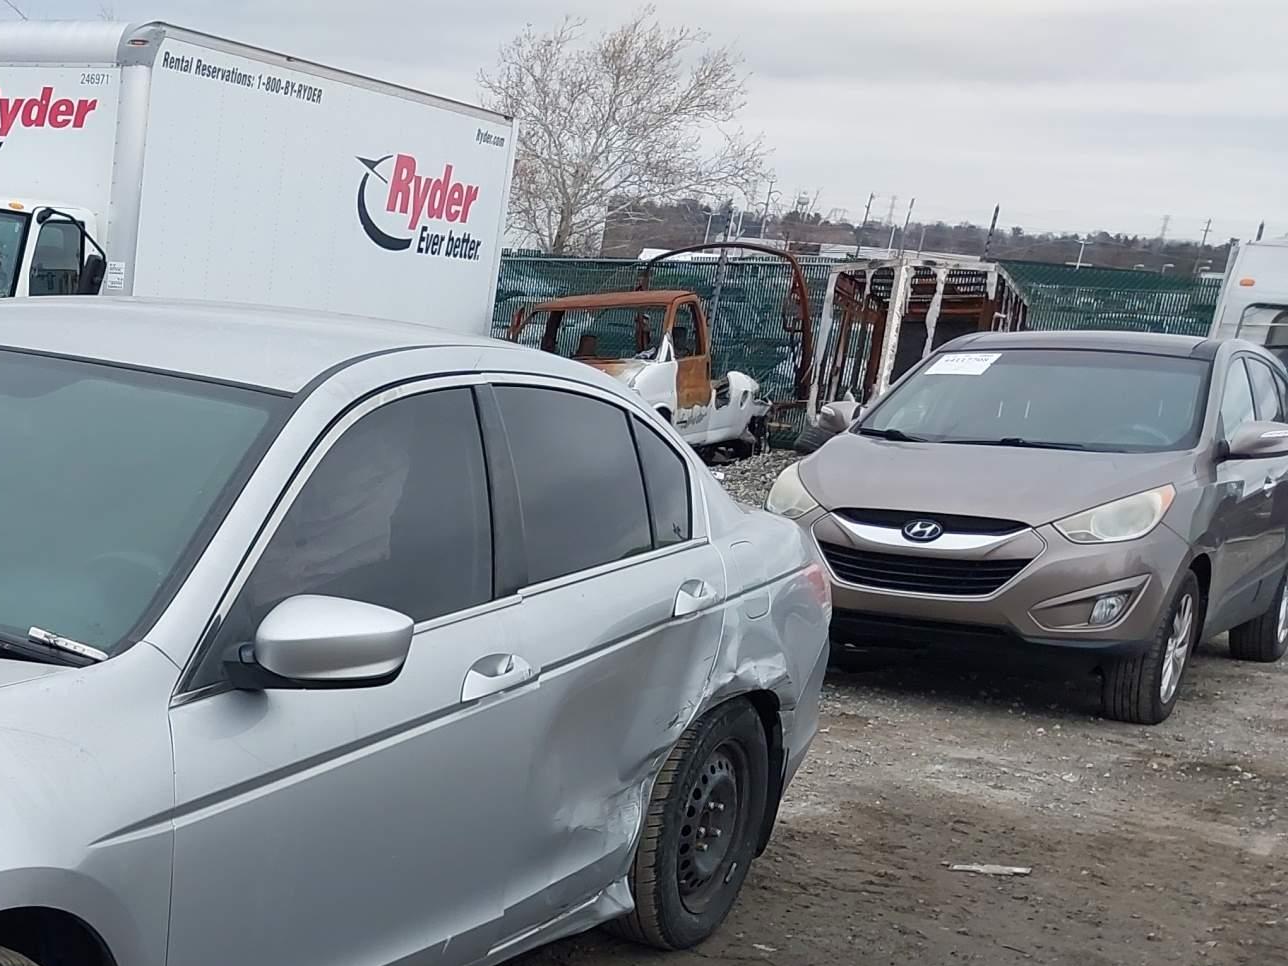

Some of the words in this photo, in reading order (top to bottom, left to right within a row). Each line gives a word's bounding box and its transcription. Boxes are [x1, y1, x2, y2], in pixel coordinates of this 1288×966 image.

[80, 73, 110, 85] 246971
[162, 51, 194, 73] Rental
[195, 59, 254, 88] Reservations:
[257, 73, 323, 104] 1-800-BY-RYDER
[475, 128, 505, 147] Ryder.com
[386, 153, 479, 230] Ryder
[416, 226, 445, 256] Ever
[445, 229, 481, 260] better.
